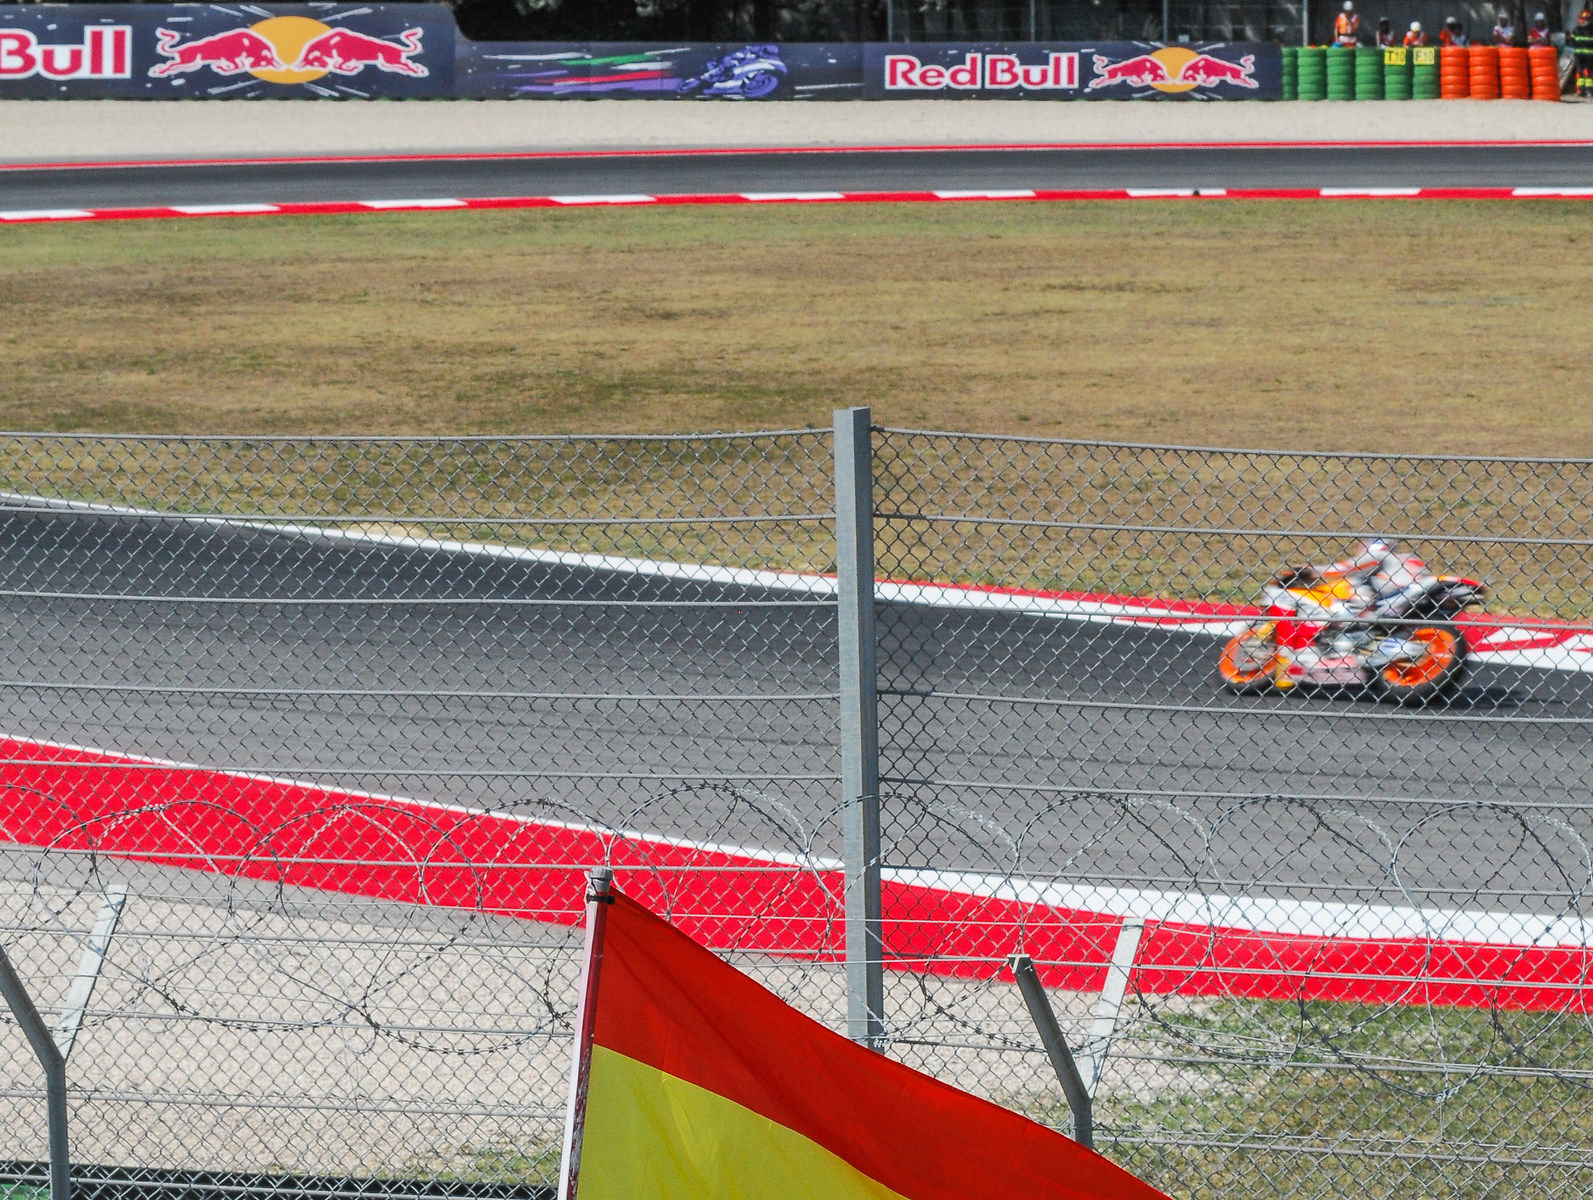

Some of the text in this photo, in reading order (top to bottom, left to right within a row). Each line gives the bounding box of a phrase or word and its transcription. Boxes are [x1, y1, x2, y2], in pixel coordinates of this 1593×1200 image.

[0, 26, 131, 79] Bull
[885, 53, 1079, 89] Red Bull
